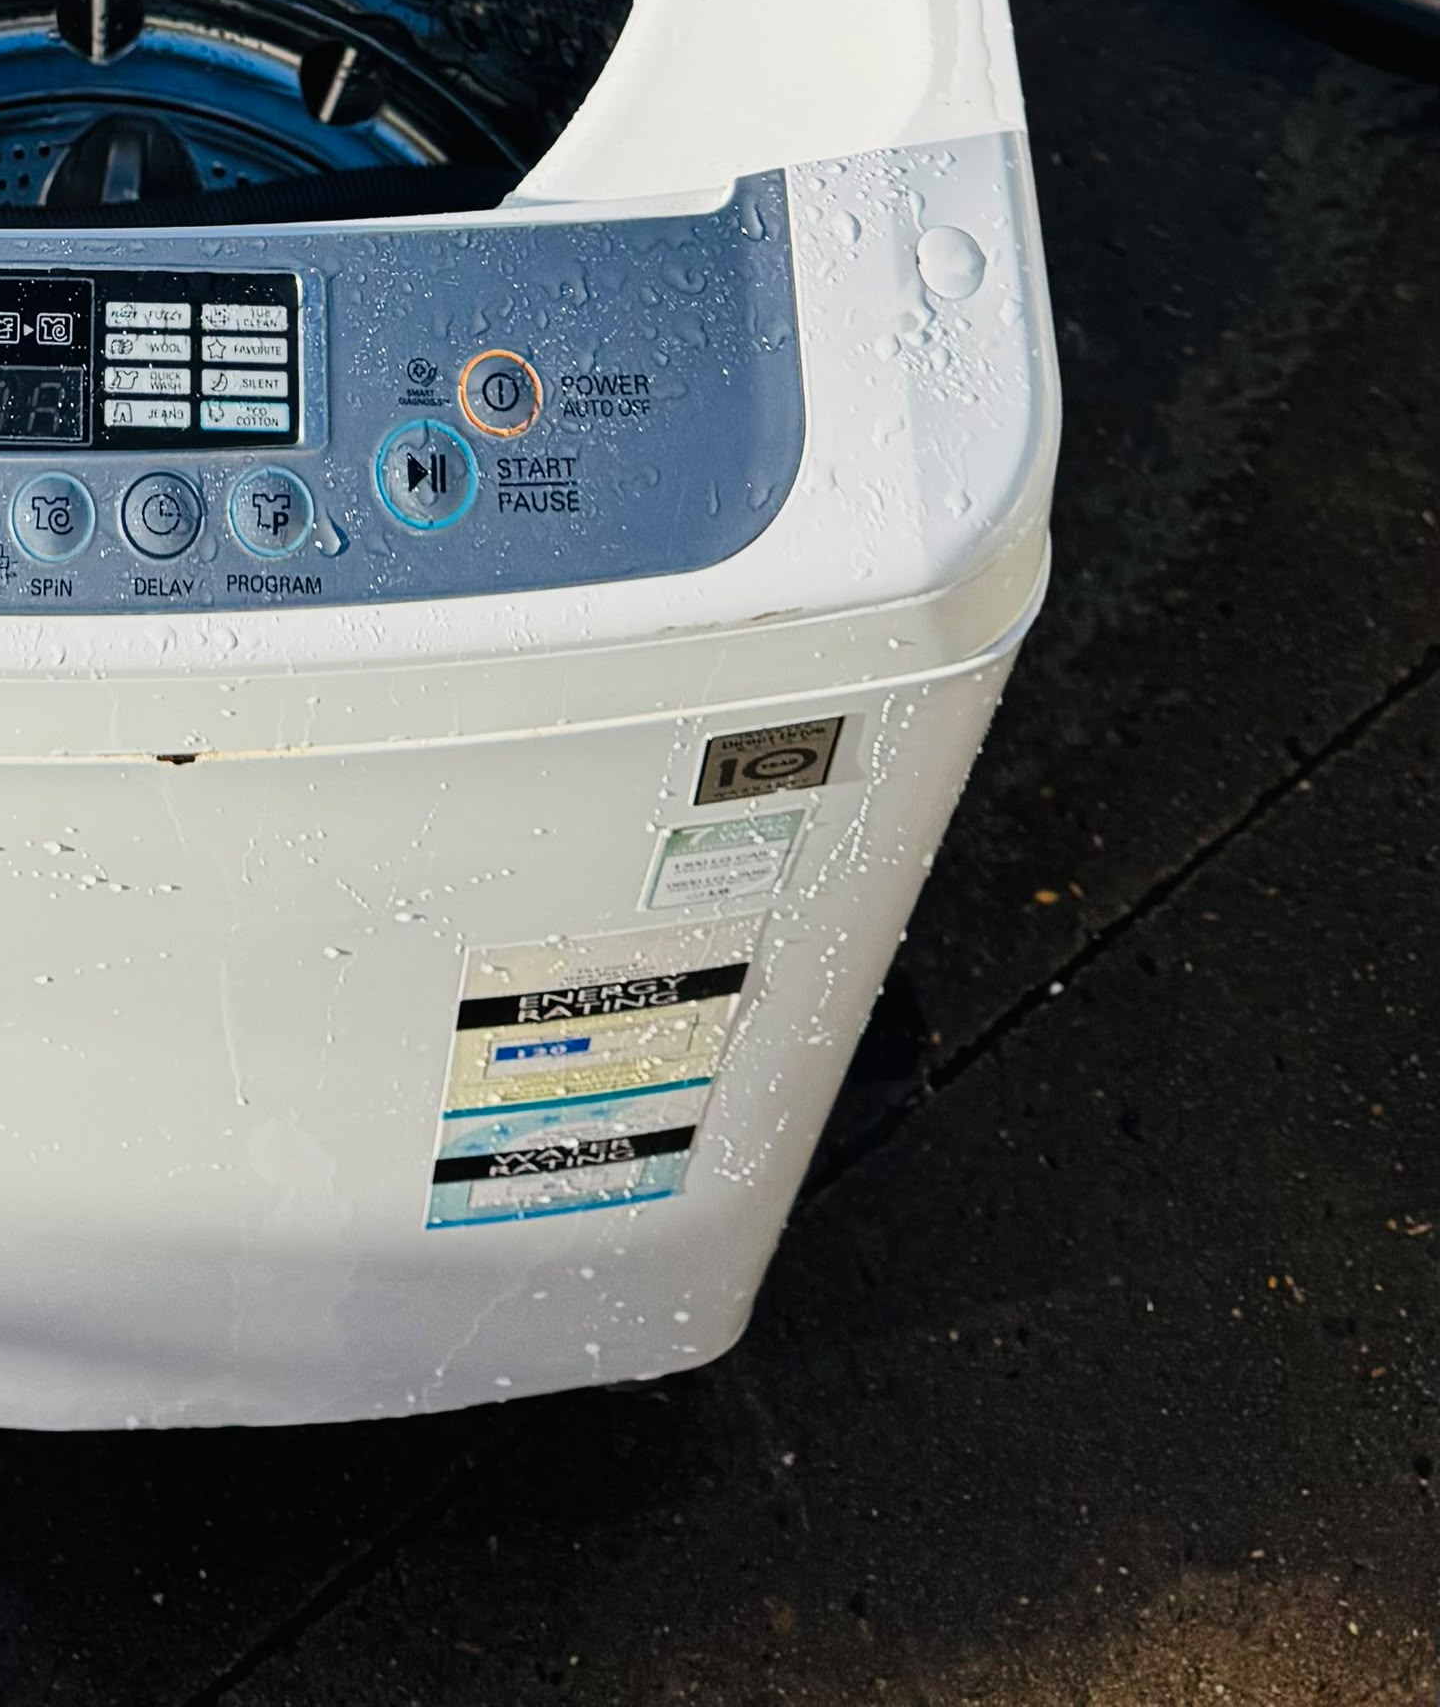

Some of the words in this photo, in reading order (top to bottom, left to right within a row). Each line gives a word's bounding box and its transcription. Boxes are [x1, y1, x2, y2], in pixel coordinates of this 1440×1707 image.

[150, 343, 182, 353] WOOL
[234, 345, 282, 356] FAVORITE
[242, 378, 279, 388] SILENT
[561, 374, 649, 395] POWER
[563, 399, 613, 417] AUTO
[236, 416, 279, 427] COTTON
[497, 457, 577, 479] START
[498, 490, 580, 513] PAUSE
[30, 578, 73, 596] SPIN
[134, 578, 194, 596] DELAY
[227, 574, 323, 595] PROGRAM
[517, 975, 687, 1009] ENERGY
[516, 990, 679, 1023] RATING
